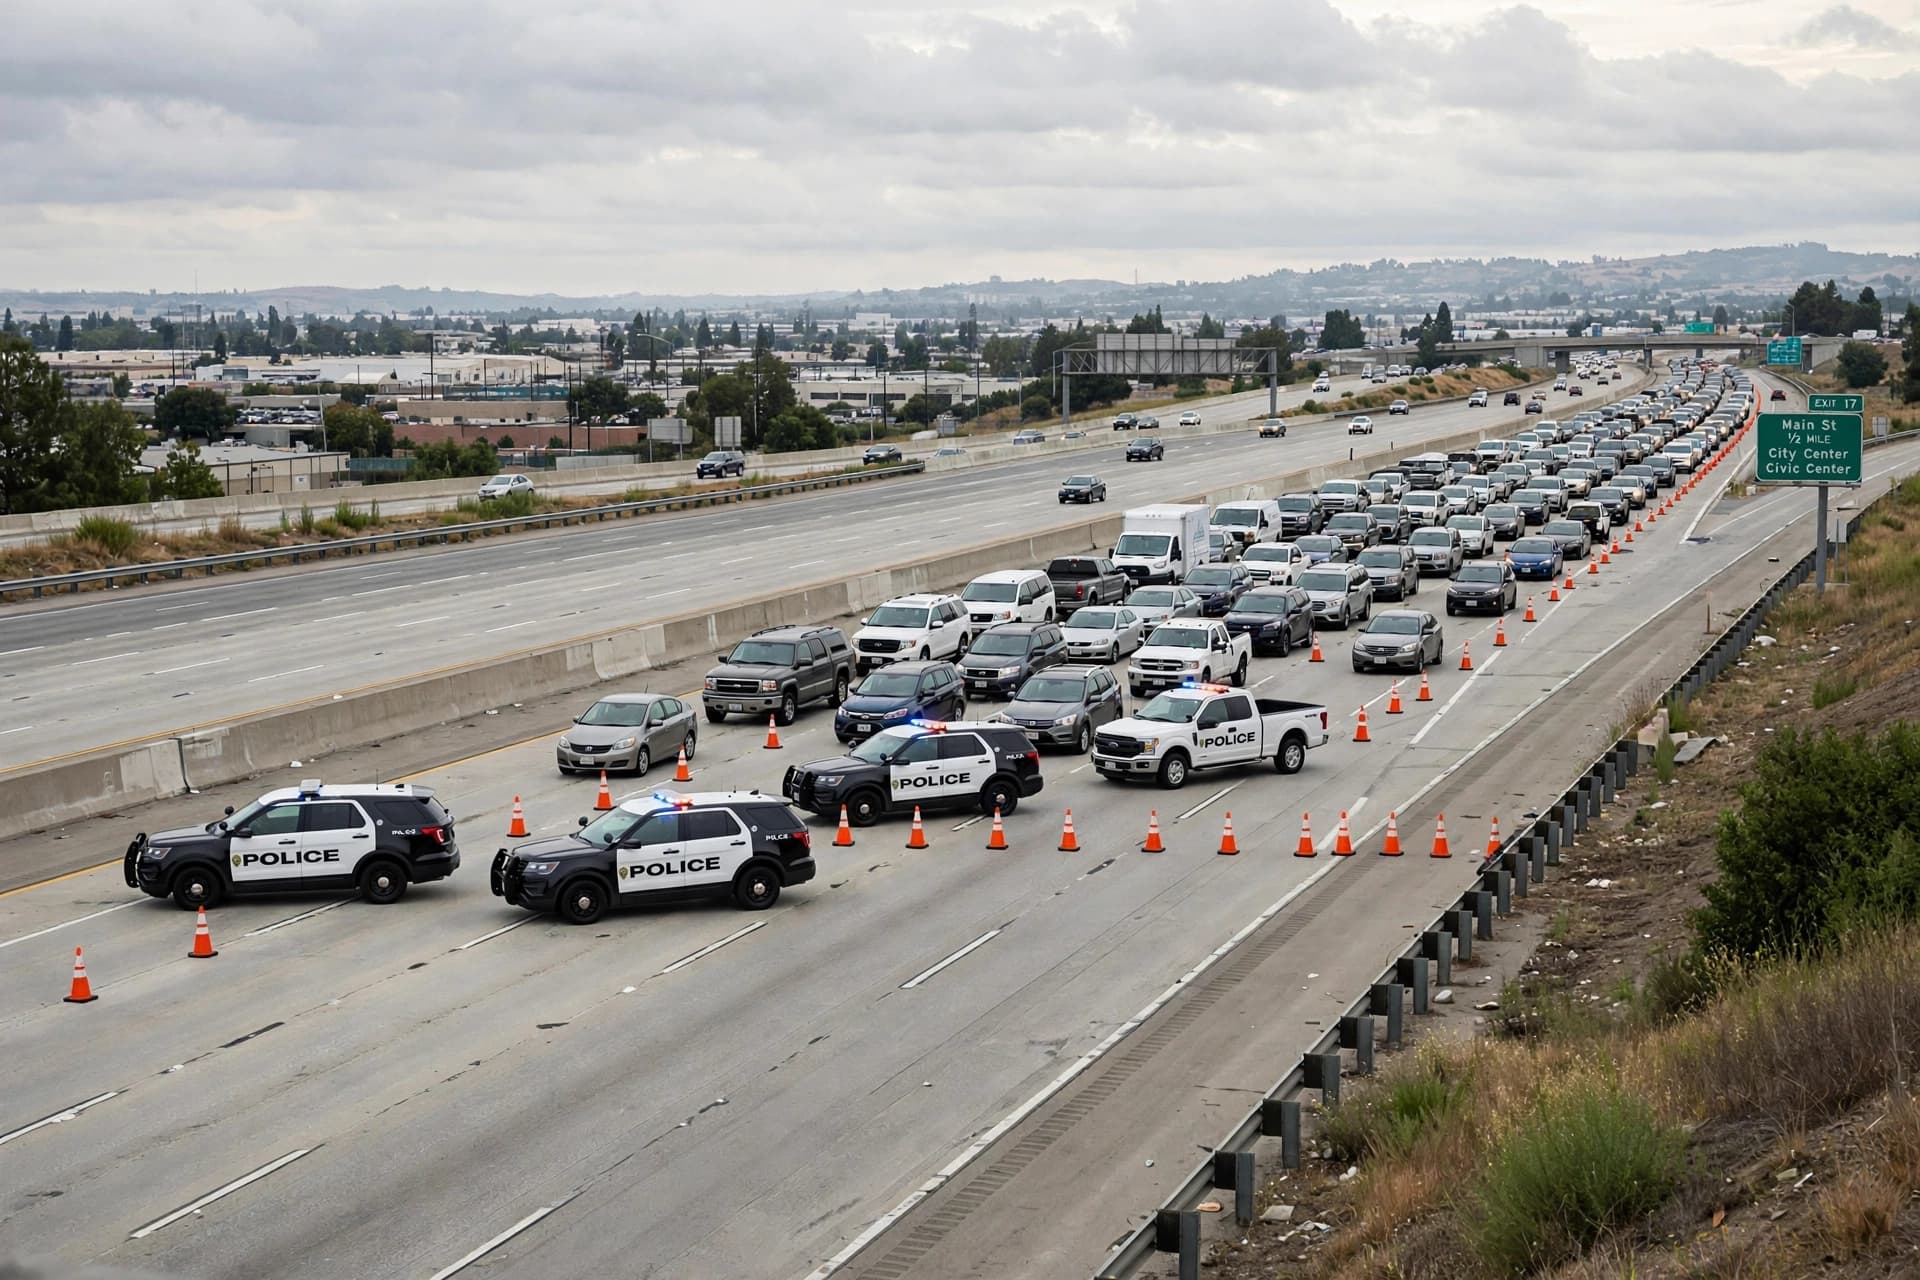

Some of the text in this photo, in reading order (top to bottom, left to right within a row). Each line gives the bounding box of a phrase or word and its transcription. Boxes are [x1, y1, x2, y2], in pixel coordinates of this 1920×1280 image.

[1814, 399, 1857, 409] EXIT 17
[1782, 419, 1837, 431] Main St
[1806, 434, 1832, 444] MILE
[1768, 447, 1849, 462] City Center
[1766, 462, 1852, 475] Civic Center
[1204, 731, 1256, 749] POLICE
[900, 772, 971, 789] POLICE
[243, 848, 340, 867] POLICE
[629, 856, 721, 879] POLICE
